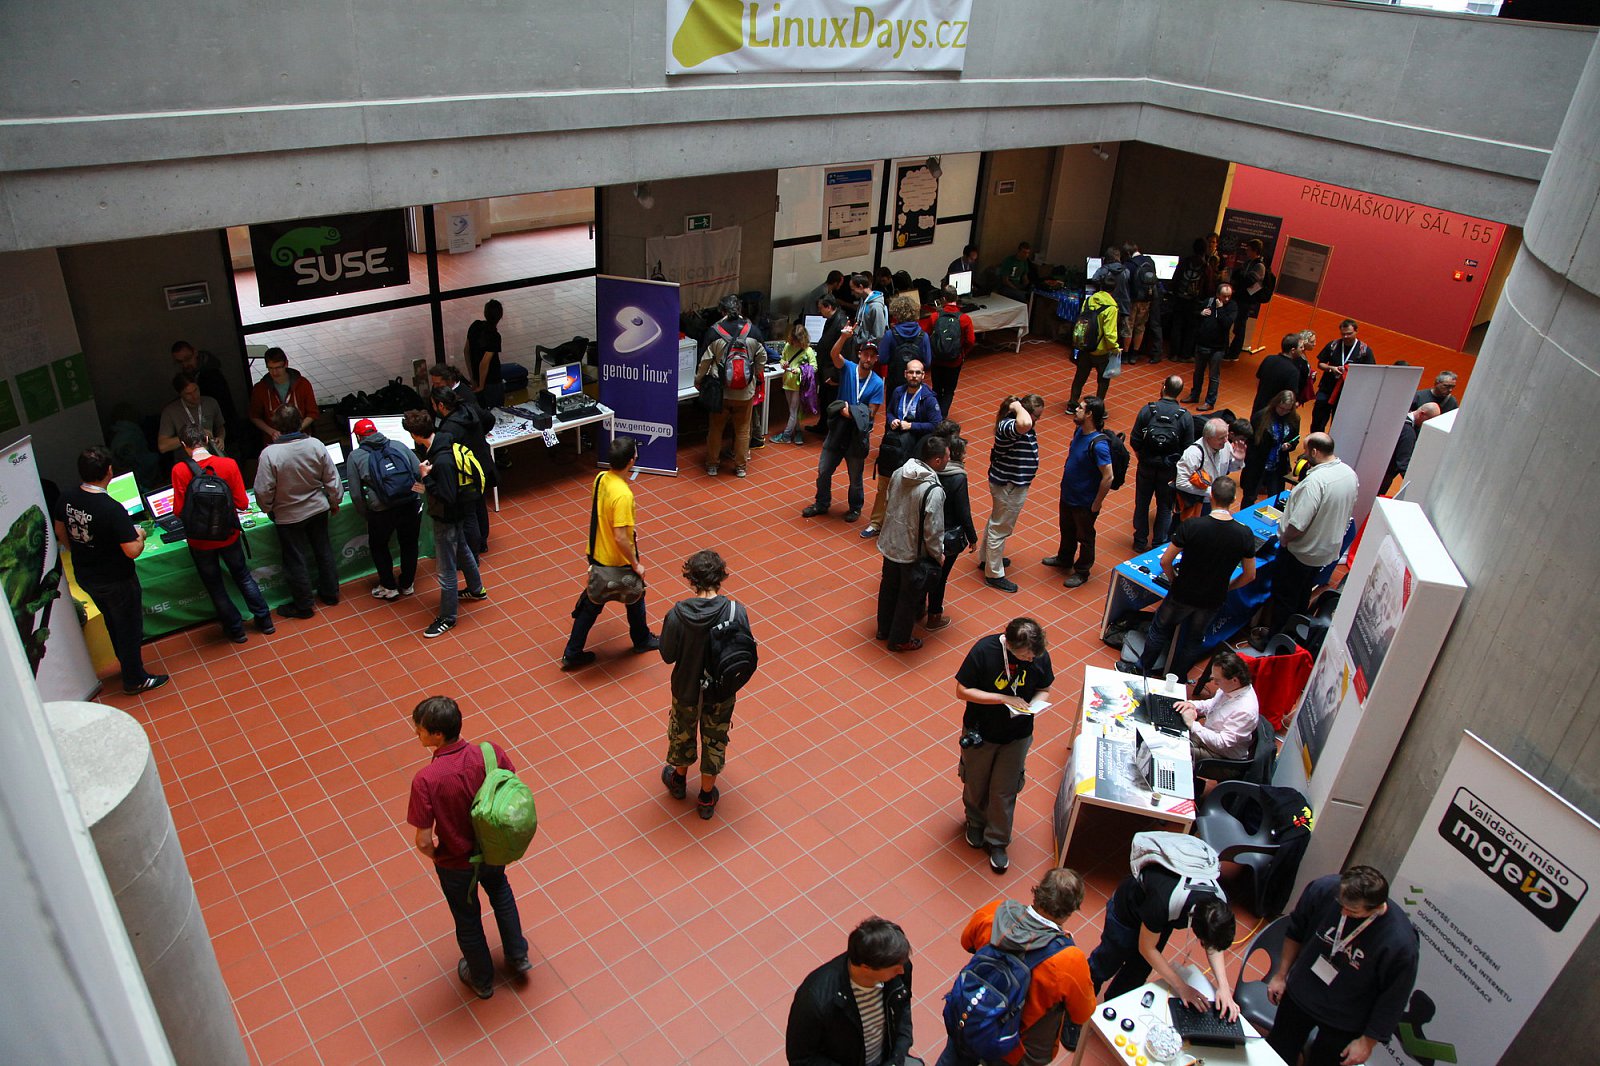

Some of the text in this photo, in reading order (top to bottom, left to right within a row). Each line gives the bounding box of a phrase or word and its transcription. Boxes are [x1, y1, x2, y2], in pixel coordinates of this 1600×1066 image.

[748, 2, 969, 59] LinuxDays.cz
[1300, 184, 1415, 226] PŘEDNÁŠKOVÝ
[1420, 212, 1451, 236] SÁL
[1462, 221, 1494, 244] 155
[293, 246, 388, 286] SUSE
[603, 363, 639, 381] gentoo
[12, 453, 28, 466] SUSE
[142, 600, 171, 615] USE
[1468, 799, 1569, 886] Validační místo
[1324, 926, 1365, 960] LAP
[1453, 963, 1493, 1003] IDENTIFIKACE
[1468, 958, 1478, 971] NA
[1478, 968, 1513, 1003] INTERNETU
